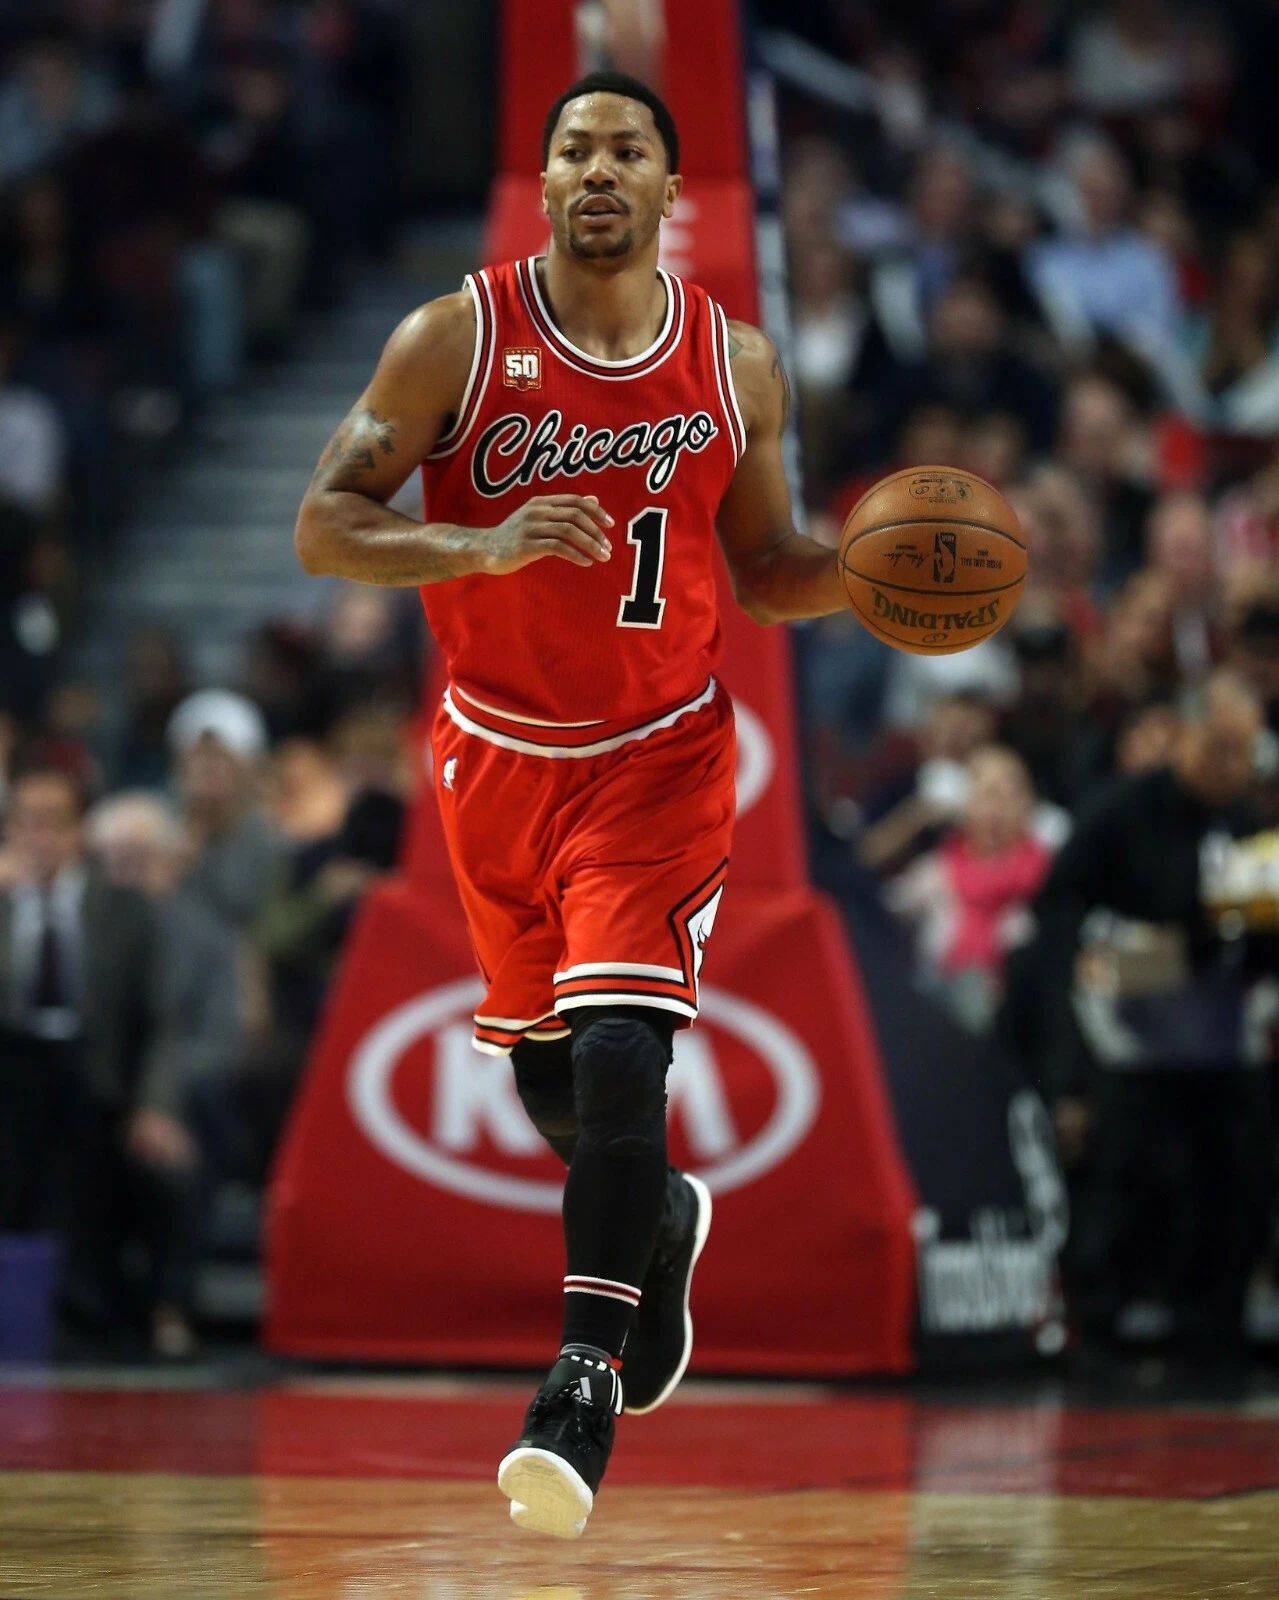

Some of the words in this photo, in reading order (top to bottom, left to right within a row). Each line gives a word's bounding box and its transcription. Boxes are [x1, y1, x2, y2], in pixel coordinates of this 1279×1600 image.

[505, 354, 539, 379] 50
[471, 409, 718, 497] Chicago
[616, 507, 668, 630] 1
[873, 591, 999, 630] SPALDING
[430, 1024, 740, 1160] KA
